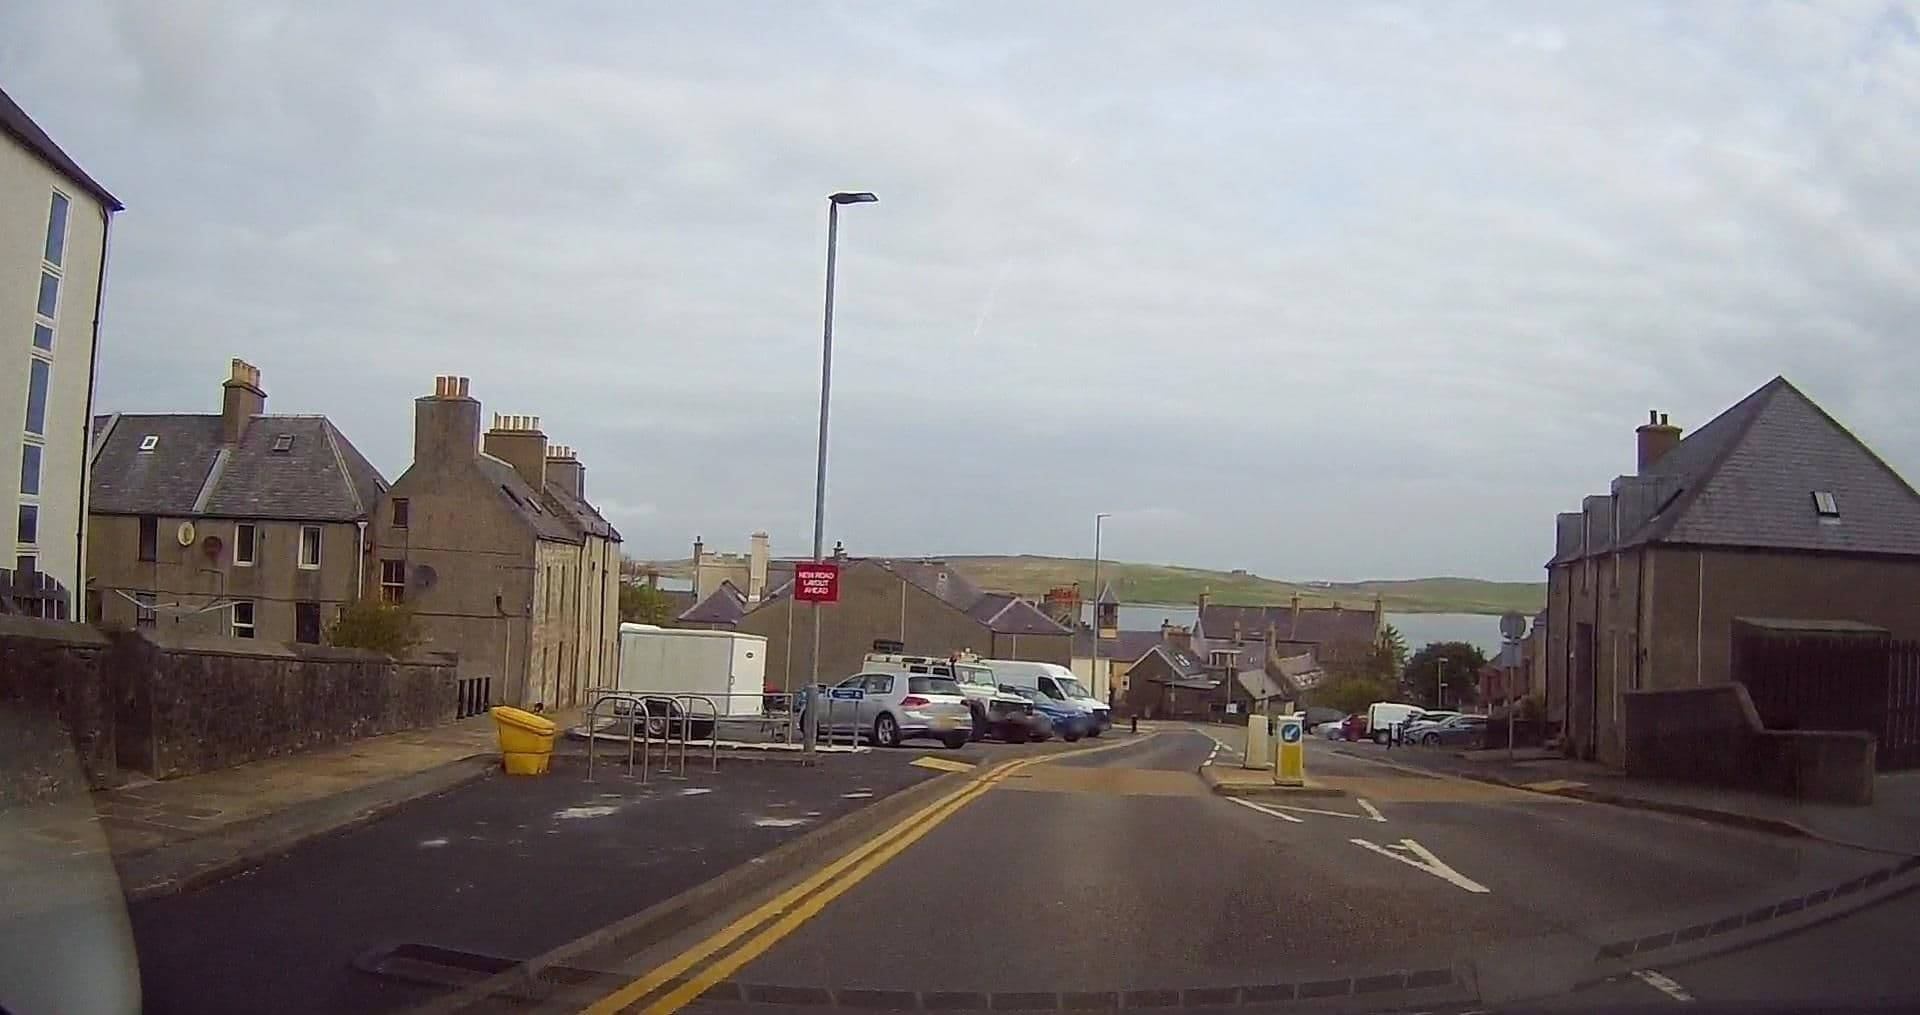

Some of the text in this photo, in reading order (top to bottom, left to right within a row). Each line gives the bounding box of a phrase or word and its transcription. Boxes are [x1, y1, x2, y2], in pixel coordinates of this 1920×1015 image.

[798, 571, 835, 580] NEW ROAD
[803, 579, 829, 587] LAYOUT
[803, 587, 829, 595] AHEAD
